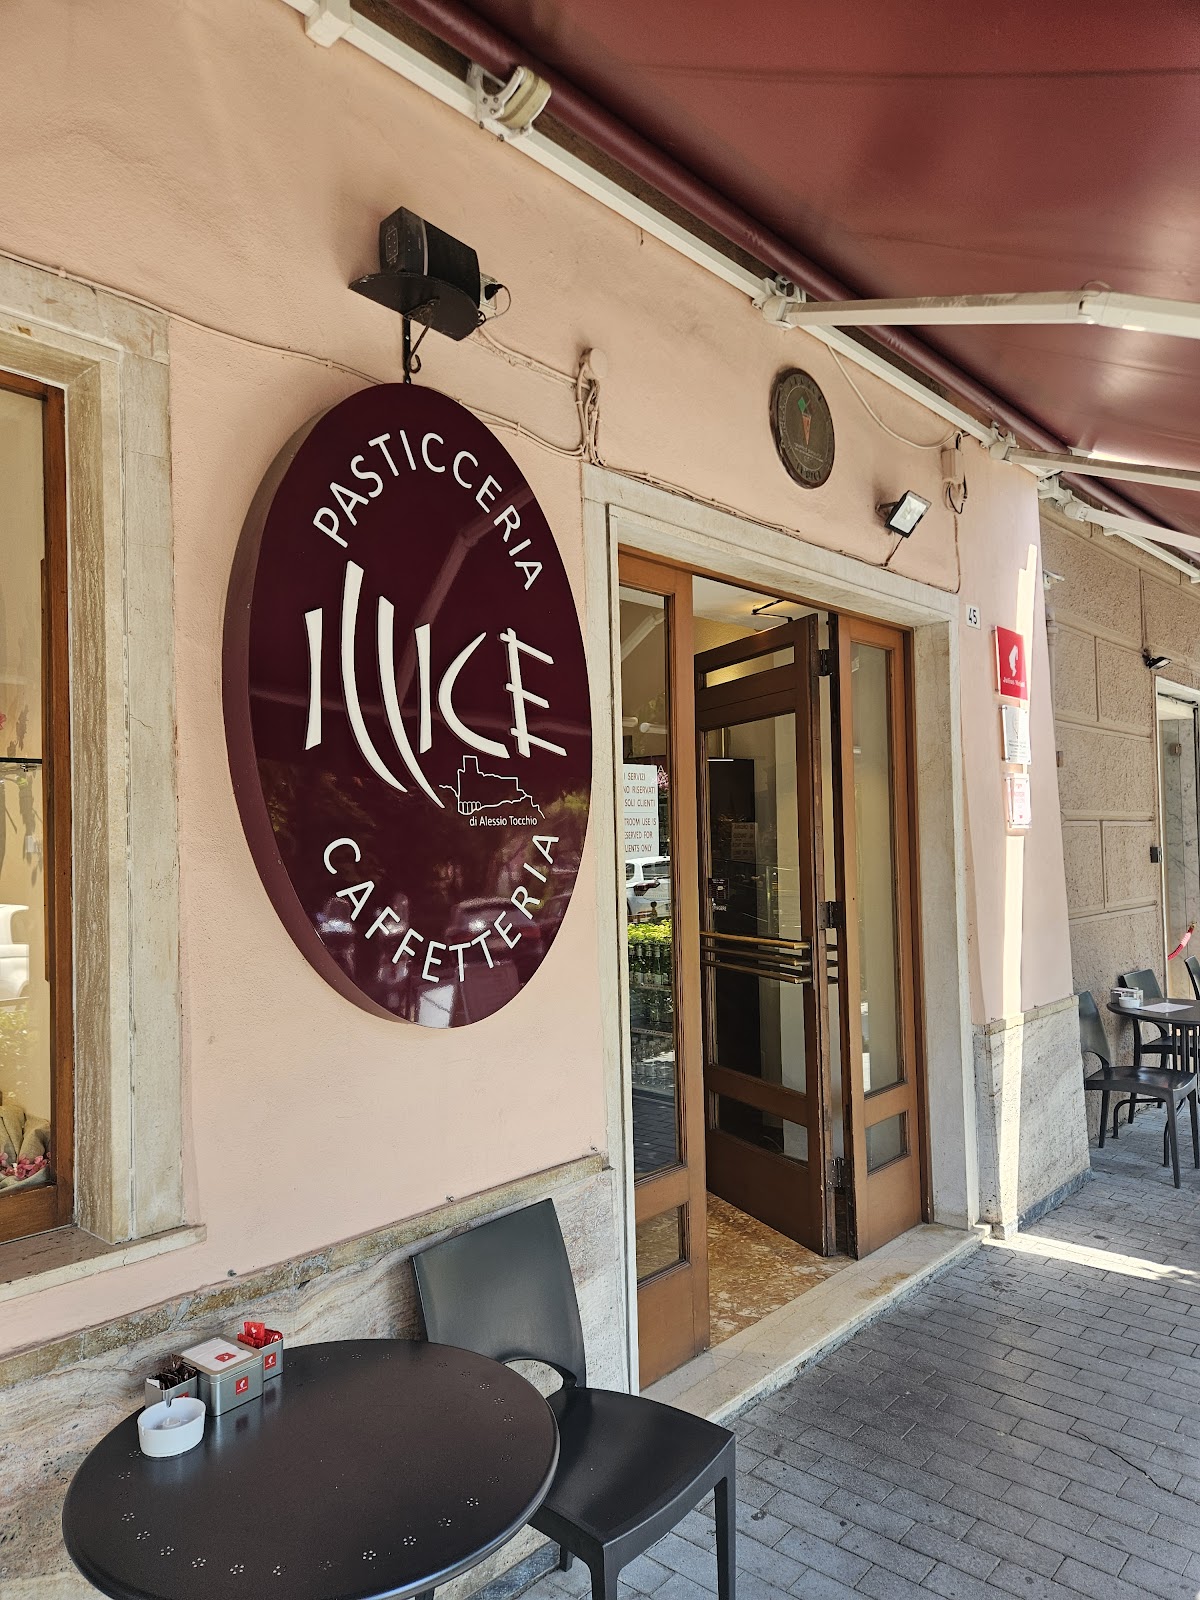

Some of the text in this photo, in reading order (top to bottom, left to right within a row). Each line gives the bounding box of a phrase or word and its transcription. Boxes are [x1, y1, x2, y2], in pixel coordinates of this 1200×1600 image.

[312, 429, 543, 591] PASTICCERIA
[968, 607, 977, 624] 45
[627, 772, 646, 781] SERVIZI
[631, 785, 656, 794] RISERVATI
[624, 798, 656, 807] SOLI CLIENTI
[469, 815, 538, 827] di Alessio Tocchio
[641, 817, 651, 826] USE
[651, 818, 657, 826] IS
[643, 830, 653, 839] FOR
[640, 843, 653, 852] ONLY
[322, 835, 560, 983] CAFFETTERIA
